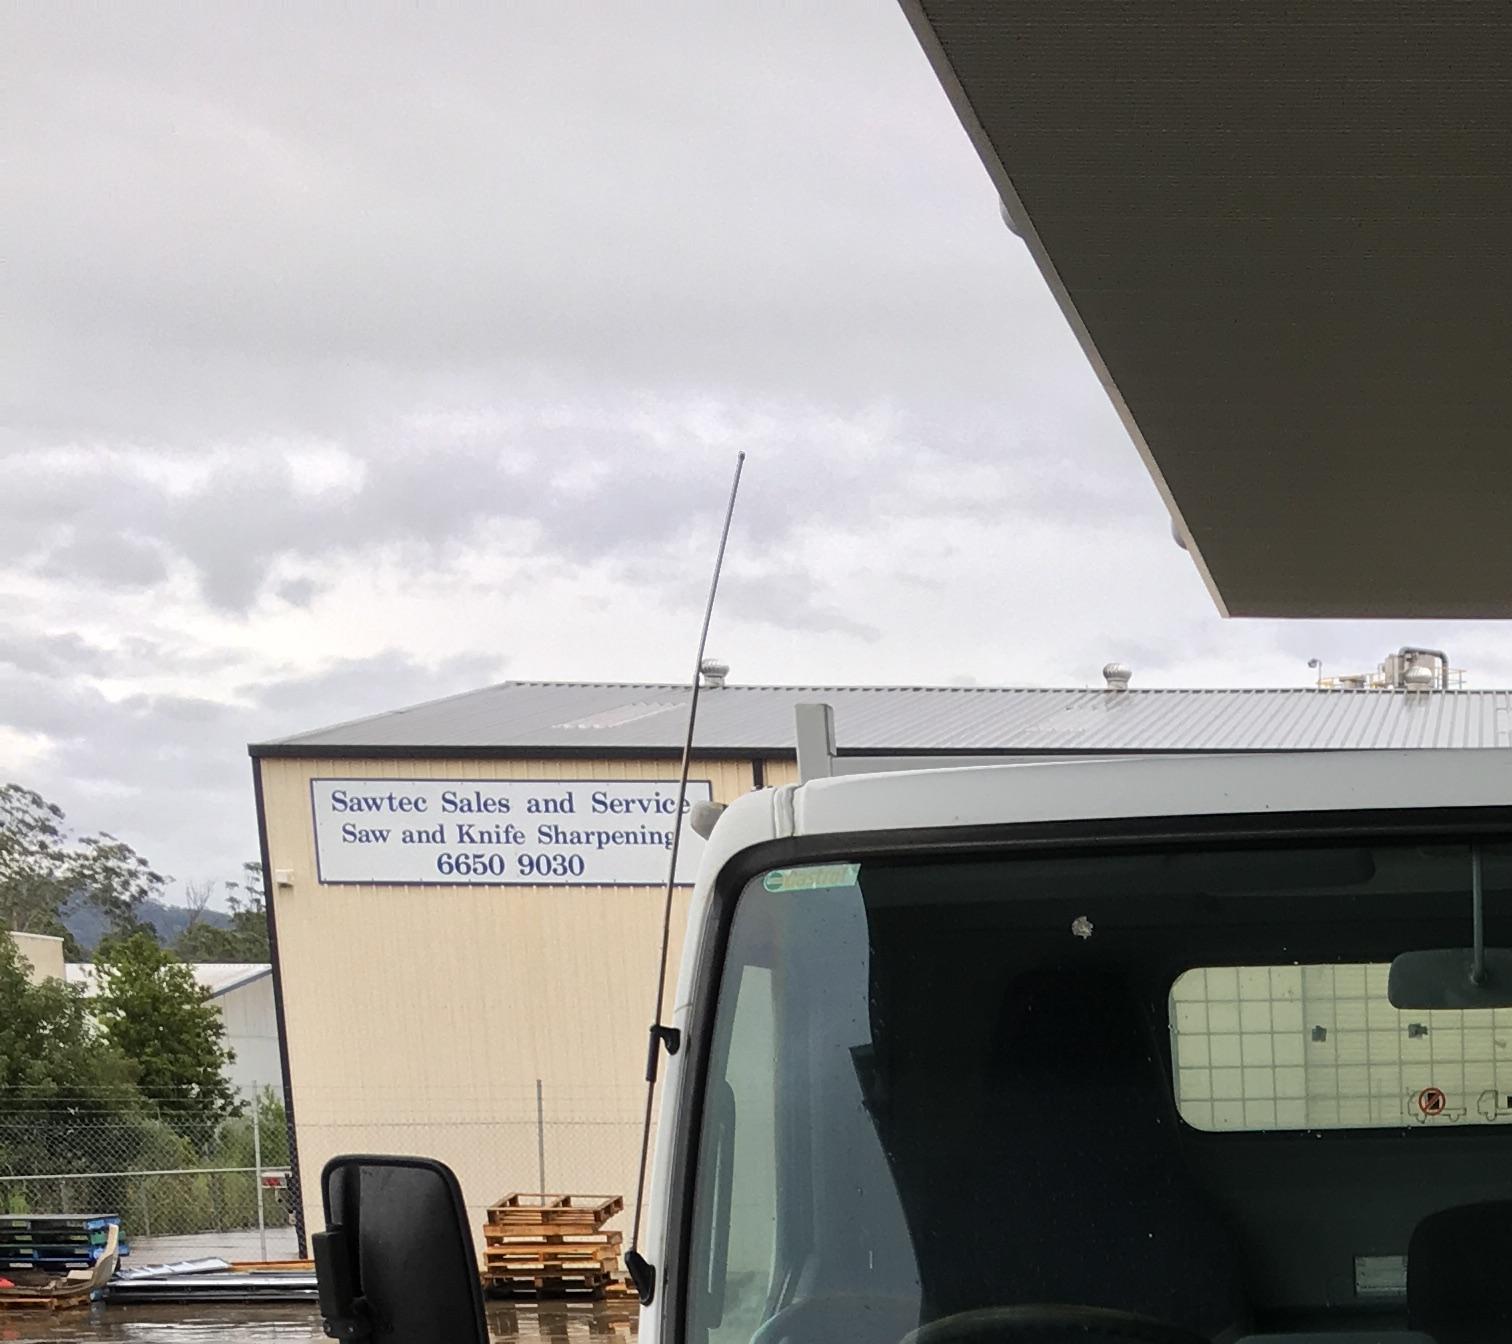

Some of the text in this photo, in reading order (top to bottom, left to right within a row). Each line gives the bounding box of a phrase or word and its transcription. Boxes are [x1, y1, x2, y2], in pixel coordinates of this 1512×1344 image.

[331, 789, 691, 814] Sawtec Sales and Service
[342, 822, 675, 850] Saw and Knife Sharpening
[436, 852, 585, 877] 6650 9030
